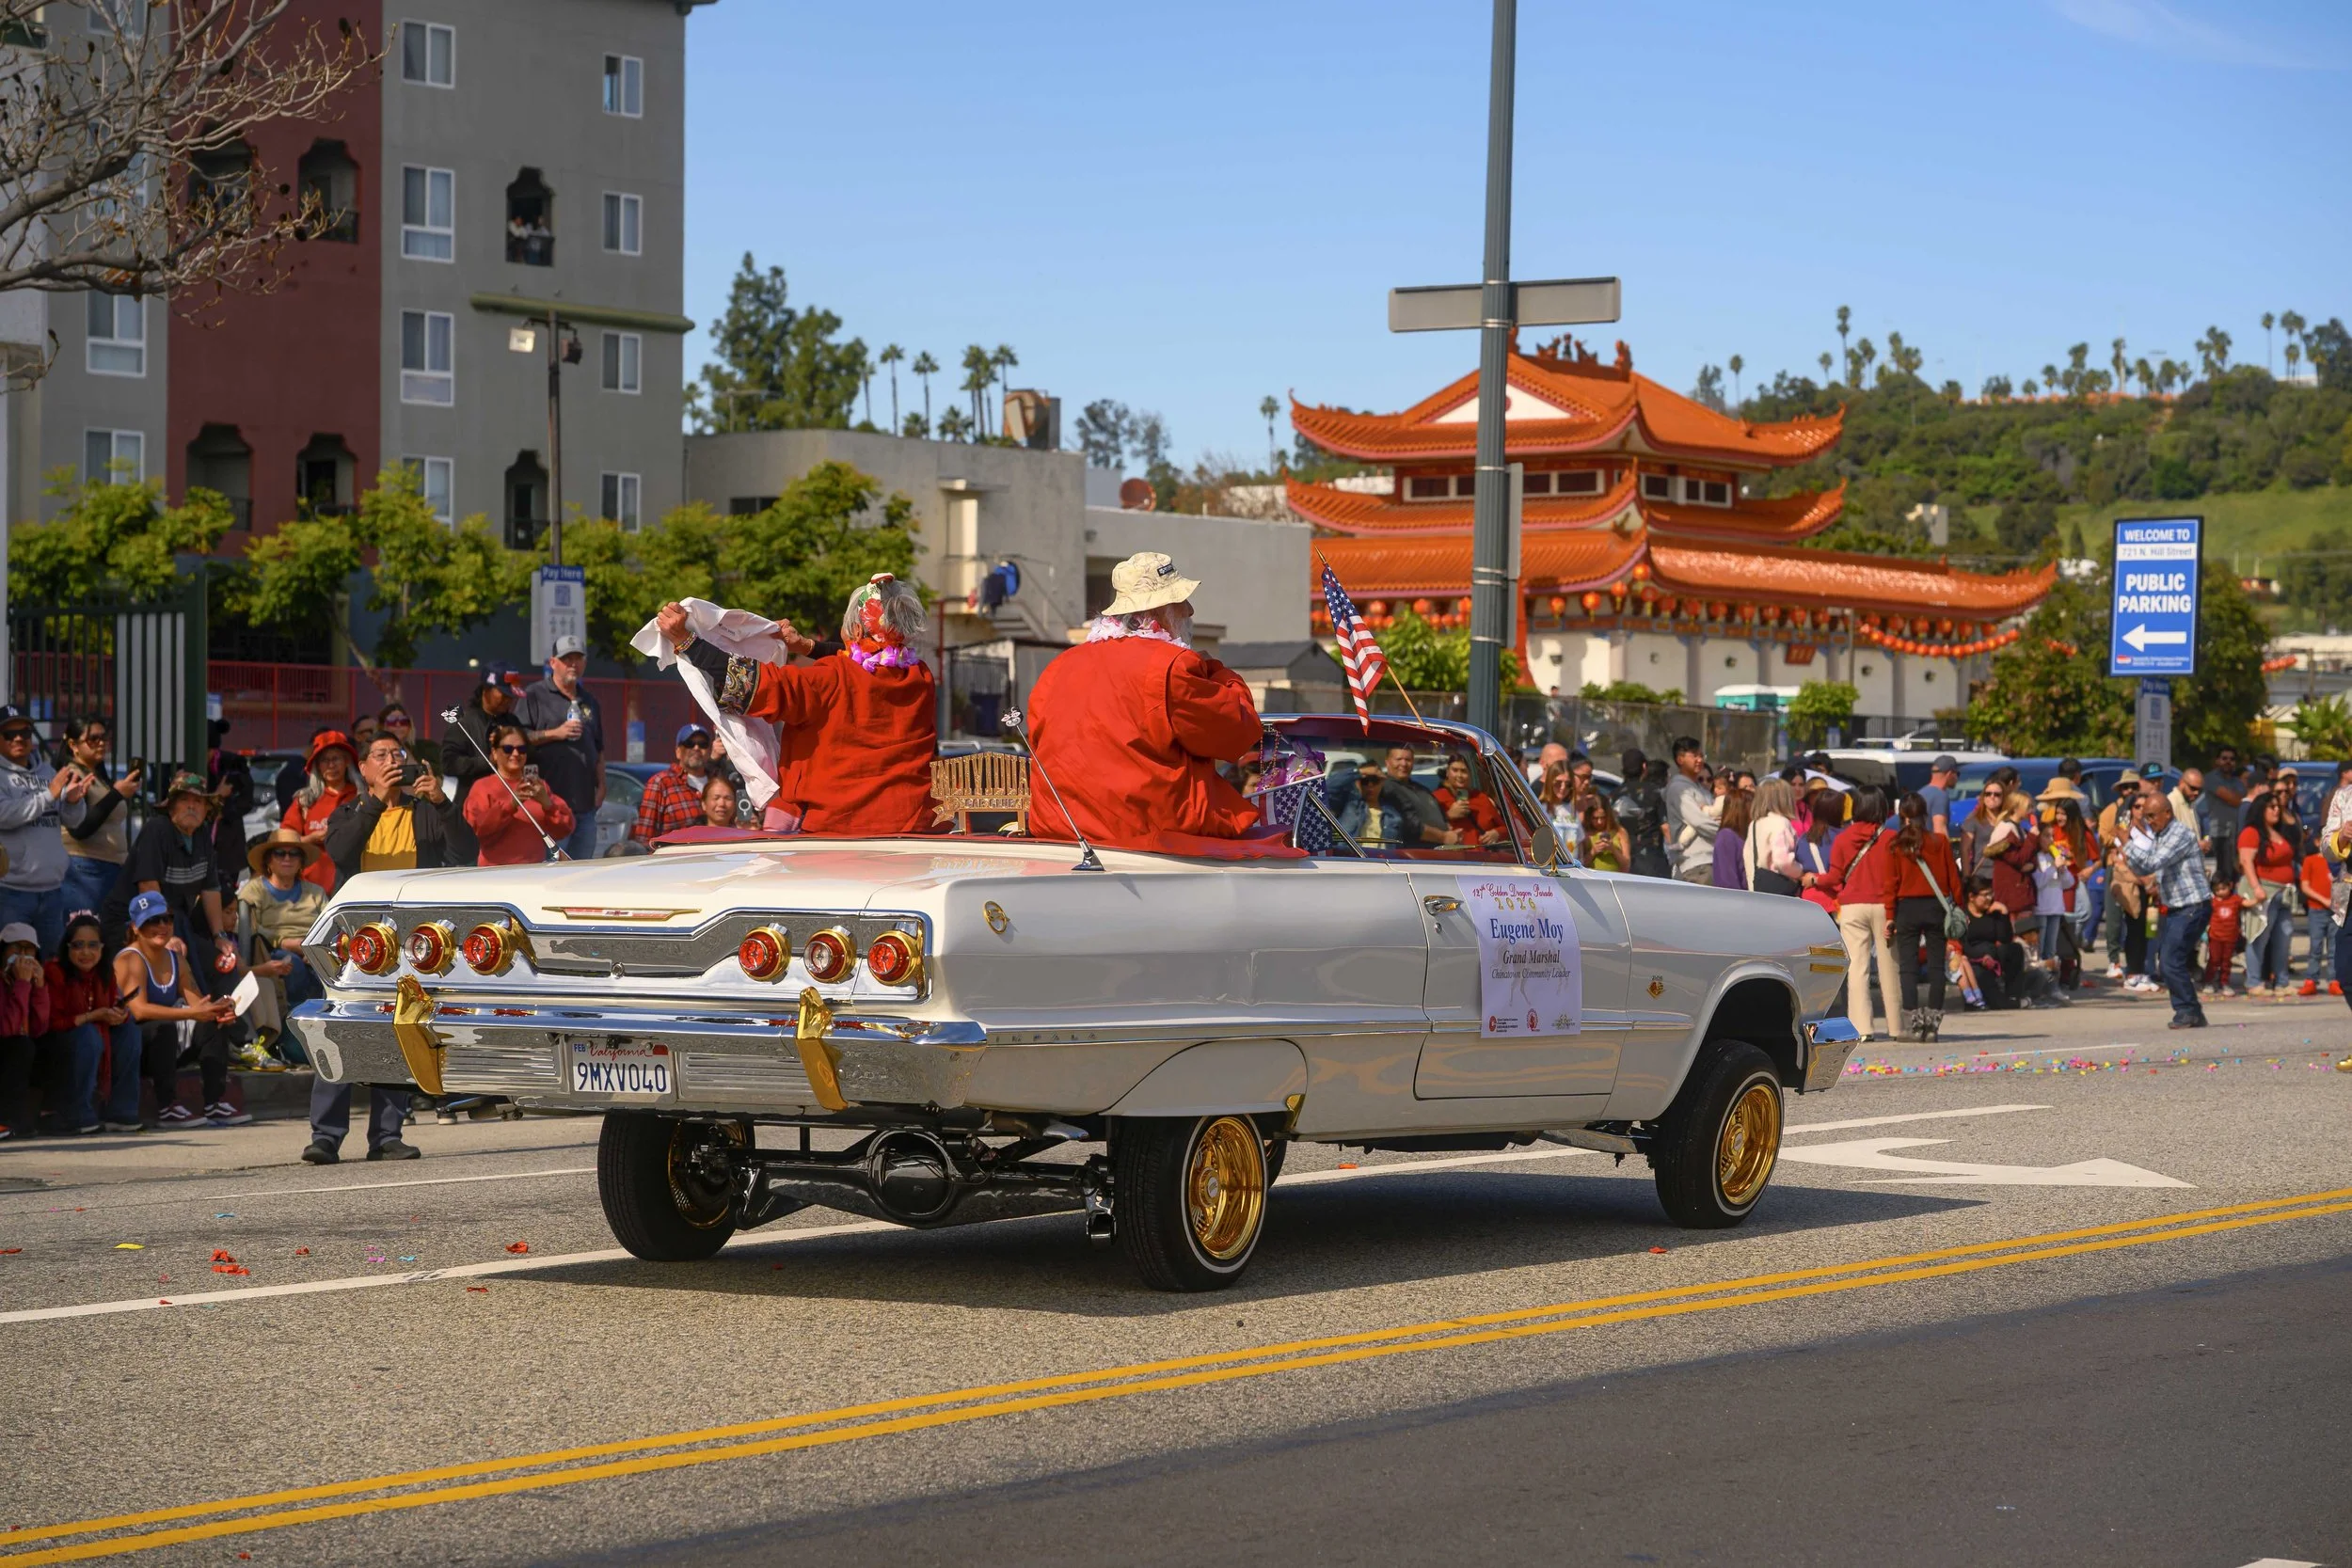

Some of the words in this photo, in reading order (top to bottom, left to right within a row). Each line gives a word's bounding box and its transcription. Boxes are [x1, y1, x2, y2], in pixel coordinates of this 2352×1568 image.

[2124, 529, 2174, 542] WELCOME
[2176, 528, 2190, 541] TO
[2122, 548, 2137, 557] 721
[2151, 547, 2164, 556] Hill
[2167, 547, 2192, 556] Street
[543, 566, 559, 579] Pay
[561, 567, 581, 579] Here
[2125, 573, 2185, 592] PUBLIC
[2119, 594, 2191, 612] PARKING
[930, 752, 1032, 797] INDIVIDUA
[1486, 883, 1508, 897] Golden
[1509, 883, 1532, 901] Dragon
[1534, 883, 1553, 897] Parade
[138, 898, 149, 910] B
[1494, 897, 1536, 911] 2026
[1490, 918, 1534, 944] Eugene
[1536, 918, 1564, 944] Moy
[1503, 950, 1526, 965] Grand
[1529, 950, 1560, 964] Marshal
[1492, 968, 1521, 979] Chinatown
[1522, 969, 1551, 980] Community
[1552, 969, 1571, 979] Leader
[590, 1043, 653, 1060] California
[578, 1062, 667, 1092] 9MXV040
